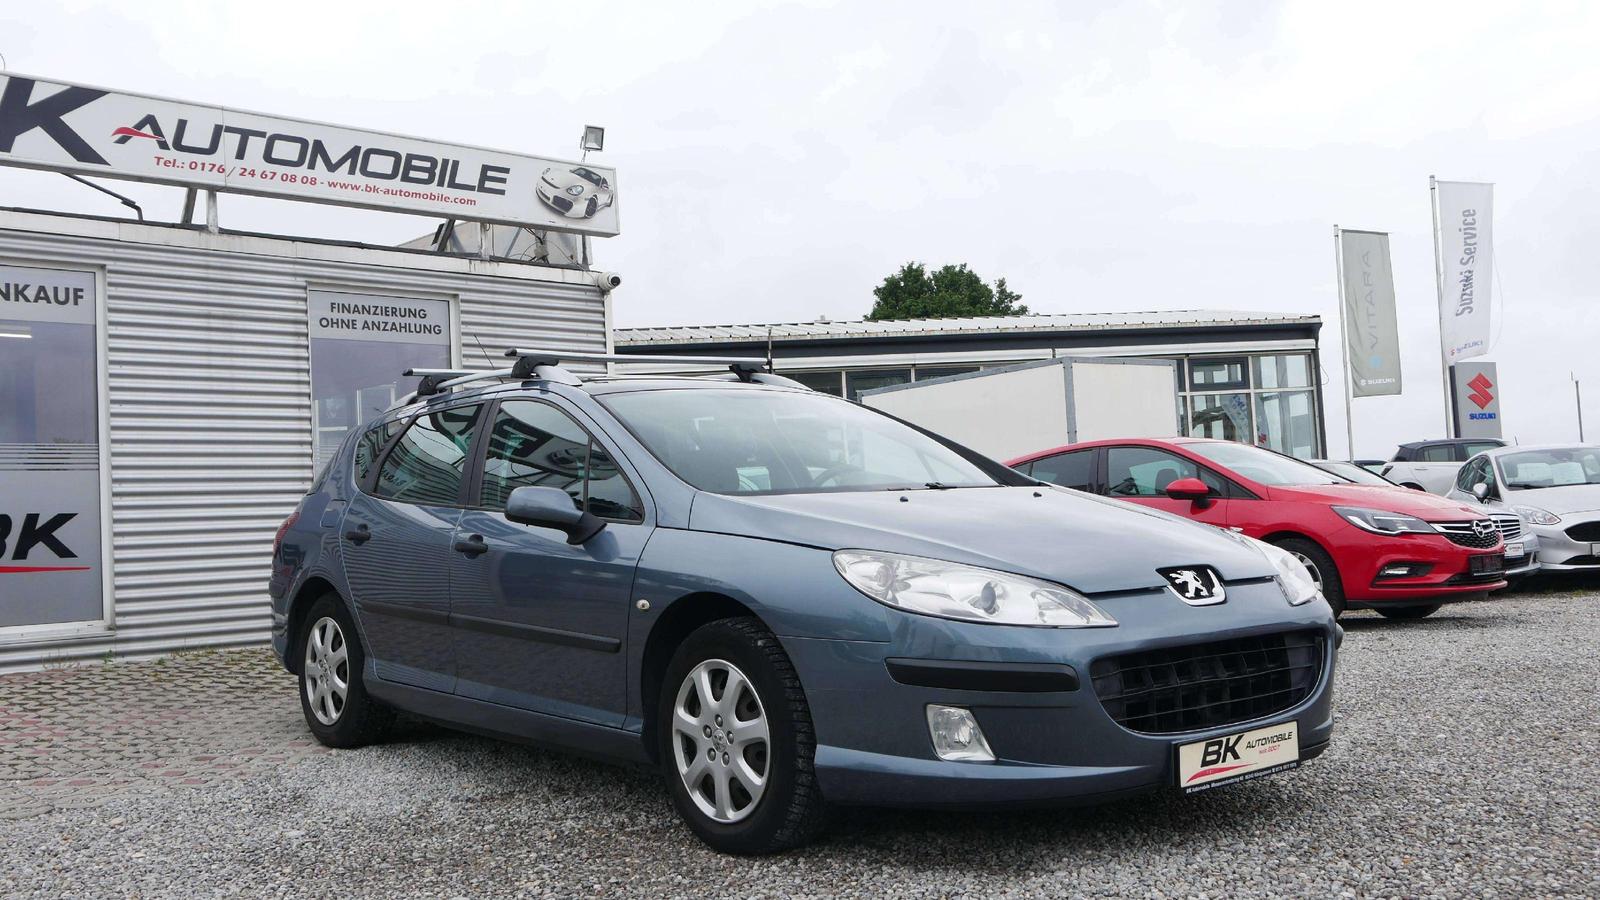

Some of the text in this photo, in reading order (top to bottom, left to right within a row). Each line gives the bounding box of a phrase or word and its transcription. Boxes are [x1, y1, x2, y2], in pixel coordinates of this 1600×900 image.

[0, 76, 511, 196] K AUTOMOBILE
[154, 156, 185, 169] Tel.:
[238, 168, 257, 178] 24
[260, 170, 277, 180] 67
[280, 172, 297, 183] 08
[300, 175, 317, 186] 08
[327, 180, 477, 206] www.bk-automobile.com
[1458, 208, 1478, 265] Service
[330, 302, 427, 319] FINANZIERUNG
[1361, 250, 1378, 351] VITARA
[319, 317, 442, 335] OHNE ANZAHLUNG
[1469, 412, 1496, 420] SUZUKI
[1201, 731, 1293, 768] BK AUTOMOBILE
